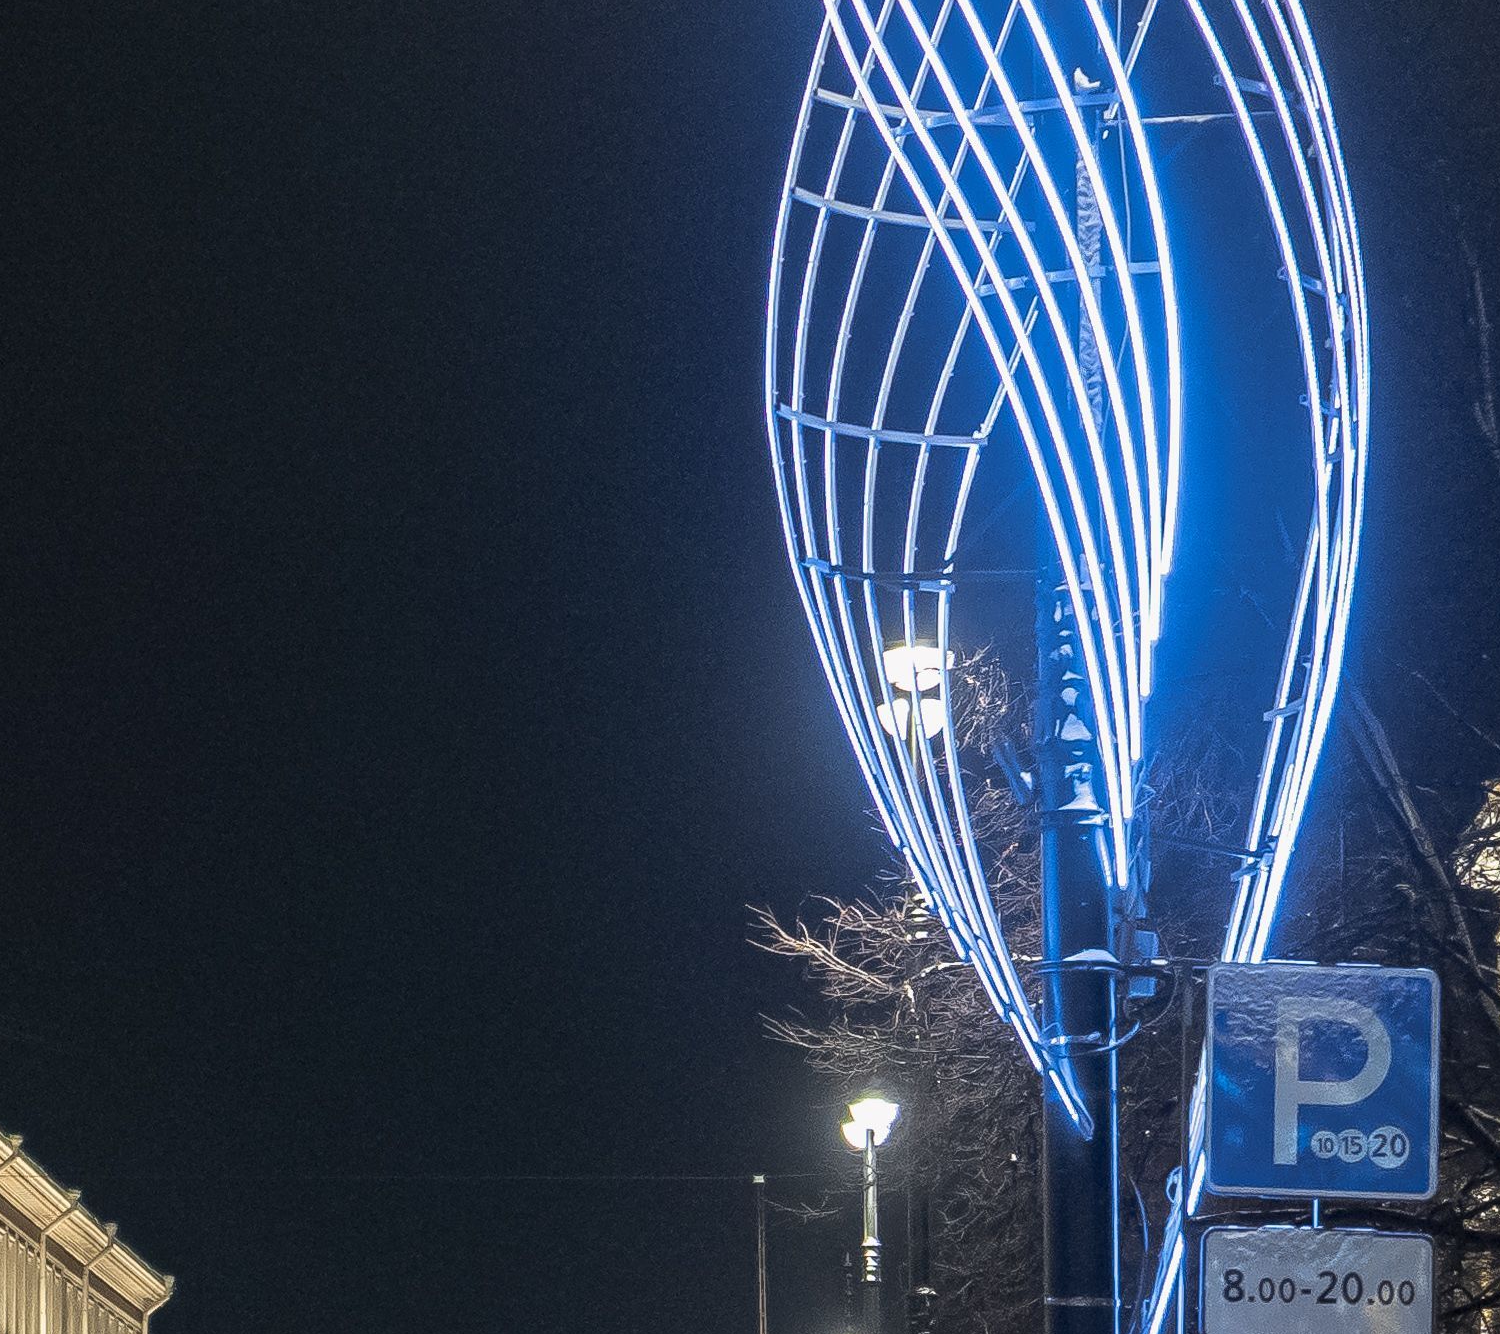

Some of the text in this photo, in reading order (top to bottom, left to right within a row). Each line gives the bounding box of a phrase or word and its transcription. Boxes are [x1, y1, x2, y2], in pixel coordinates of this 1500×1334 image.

[1273, 995, 1392, 1166] P
[1317, 1133, 1408, 1158] 10 15 20
[1222, 1268, 1416, 1307] 8.00-20.00
